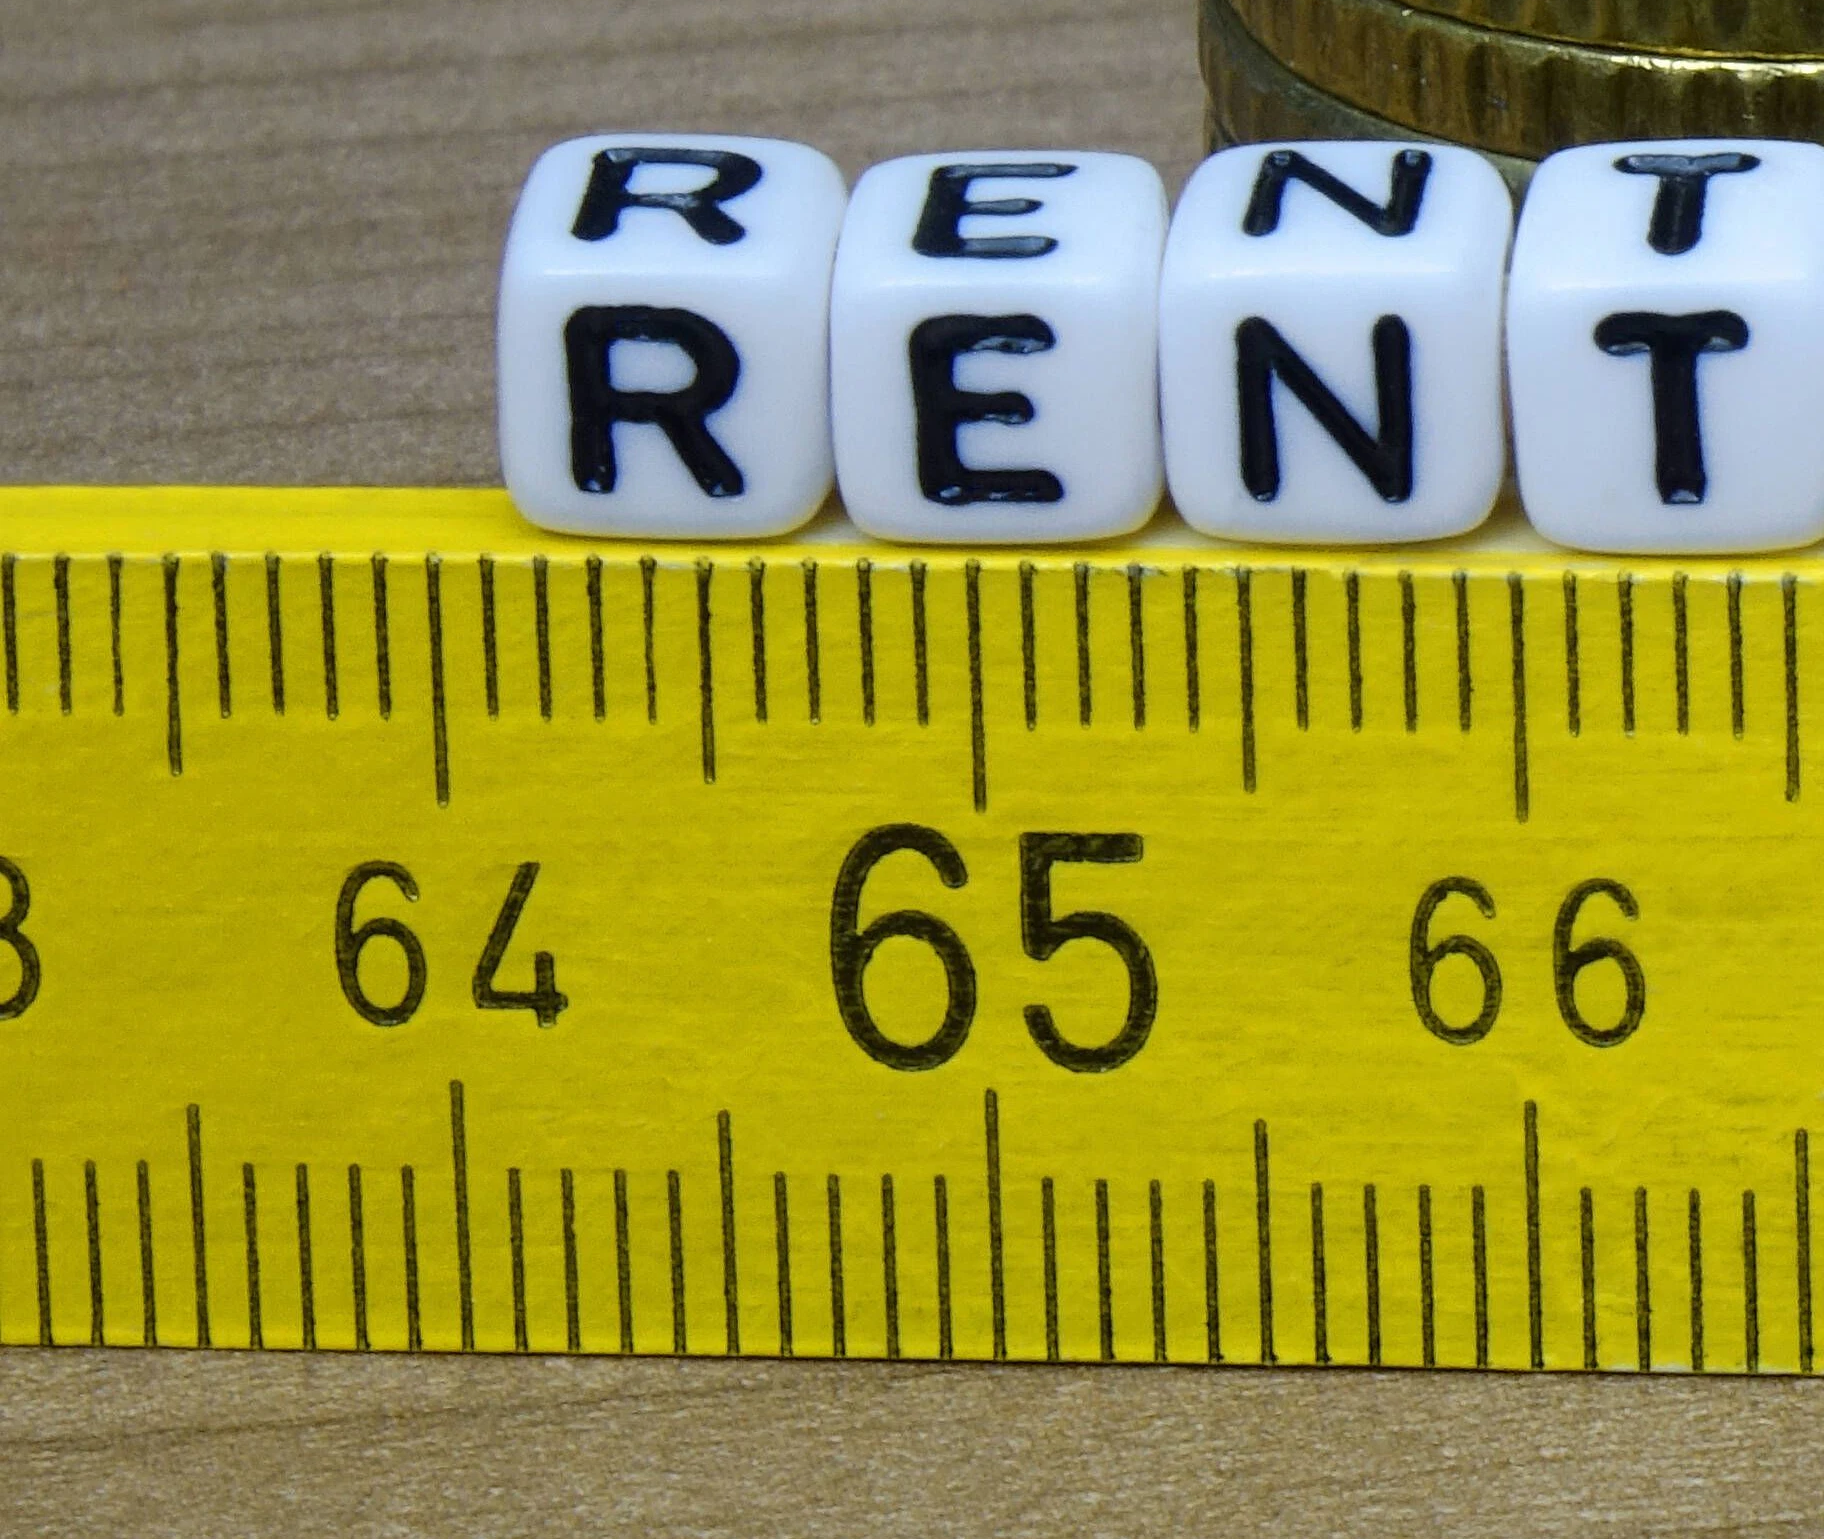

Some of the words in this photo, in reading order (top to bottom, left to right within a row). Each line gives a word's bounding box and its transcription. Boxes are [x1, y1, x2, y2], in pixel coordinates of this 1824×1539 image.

[335, 861, 568, 1027] 64
[830, 823, 1158, 1073] 65
[1410, 877, 1645, 1048] 66
